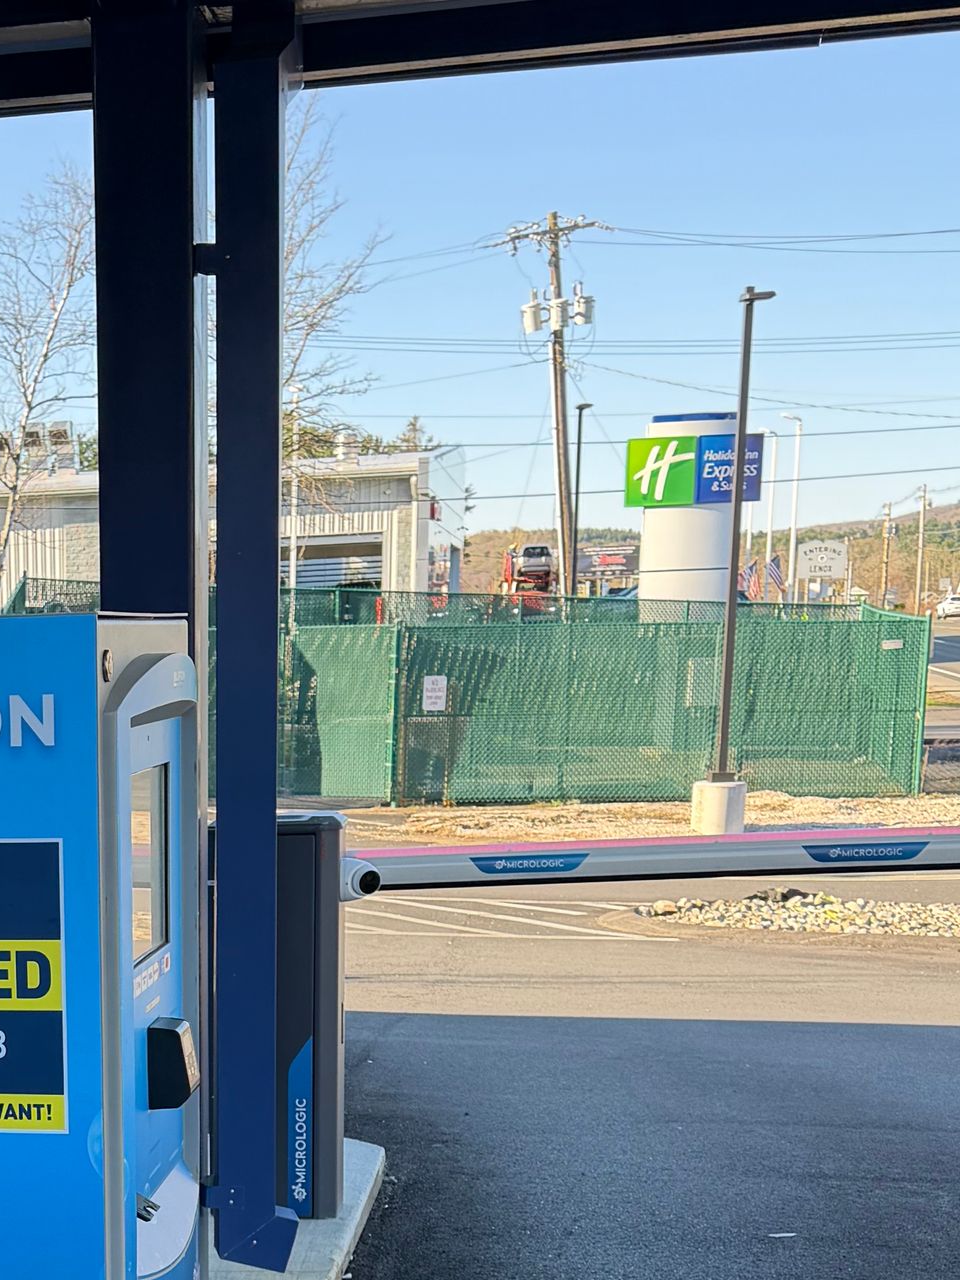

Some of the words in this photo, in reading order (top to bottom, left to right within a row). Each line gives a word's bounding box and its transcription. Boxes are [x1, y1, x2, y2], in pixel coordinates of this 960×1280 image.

[702, 462, 759, 481] Exprss
[803, 546, 843, 556] ENTERING
[809, 565, 832, 573] LENOX
[842, 847, 903, 858] MICROLOGIC
[507, 859, 565, 869] MICROLOGIC
[295, 1098, 307, 1183] MICROLOGIC
